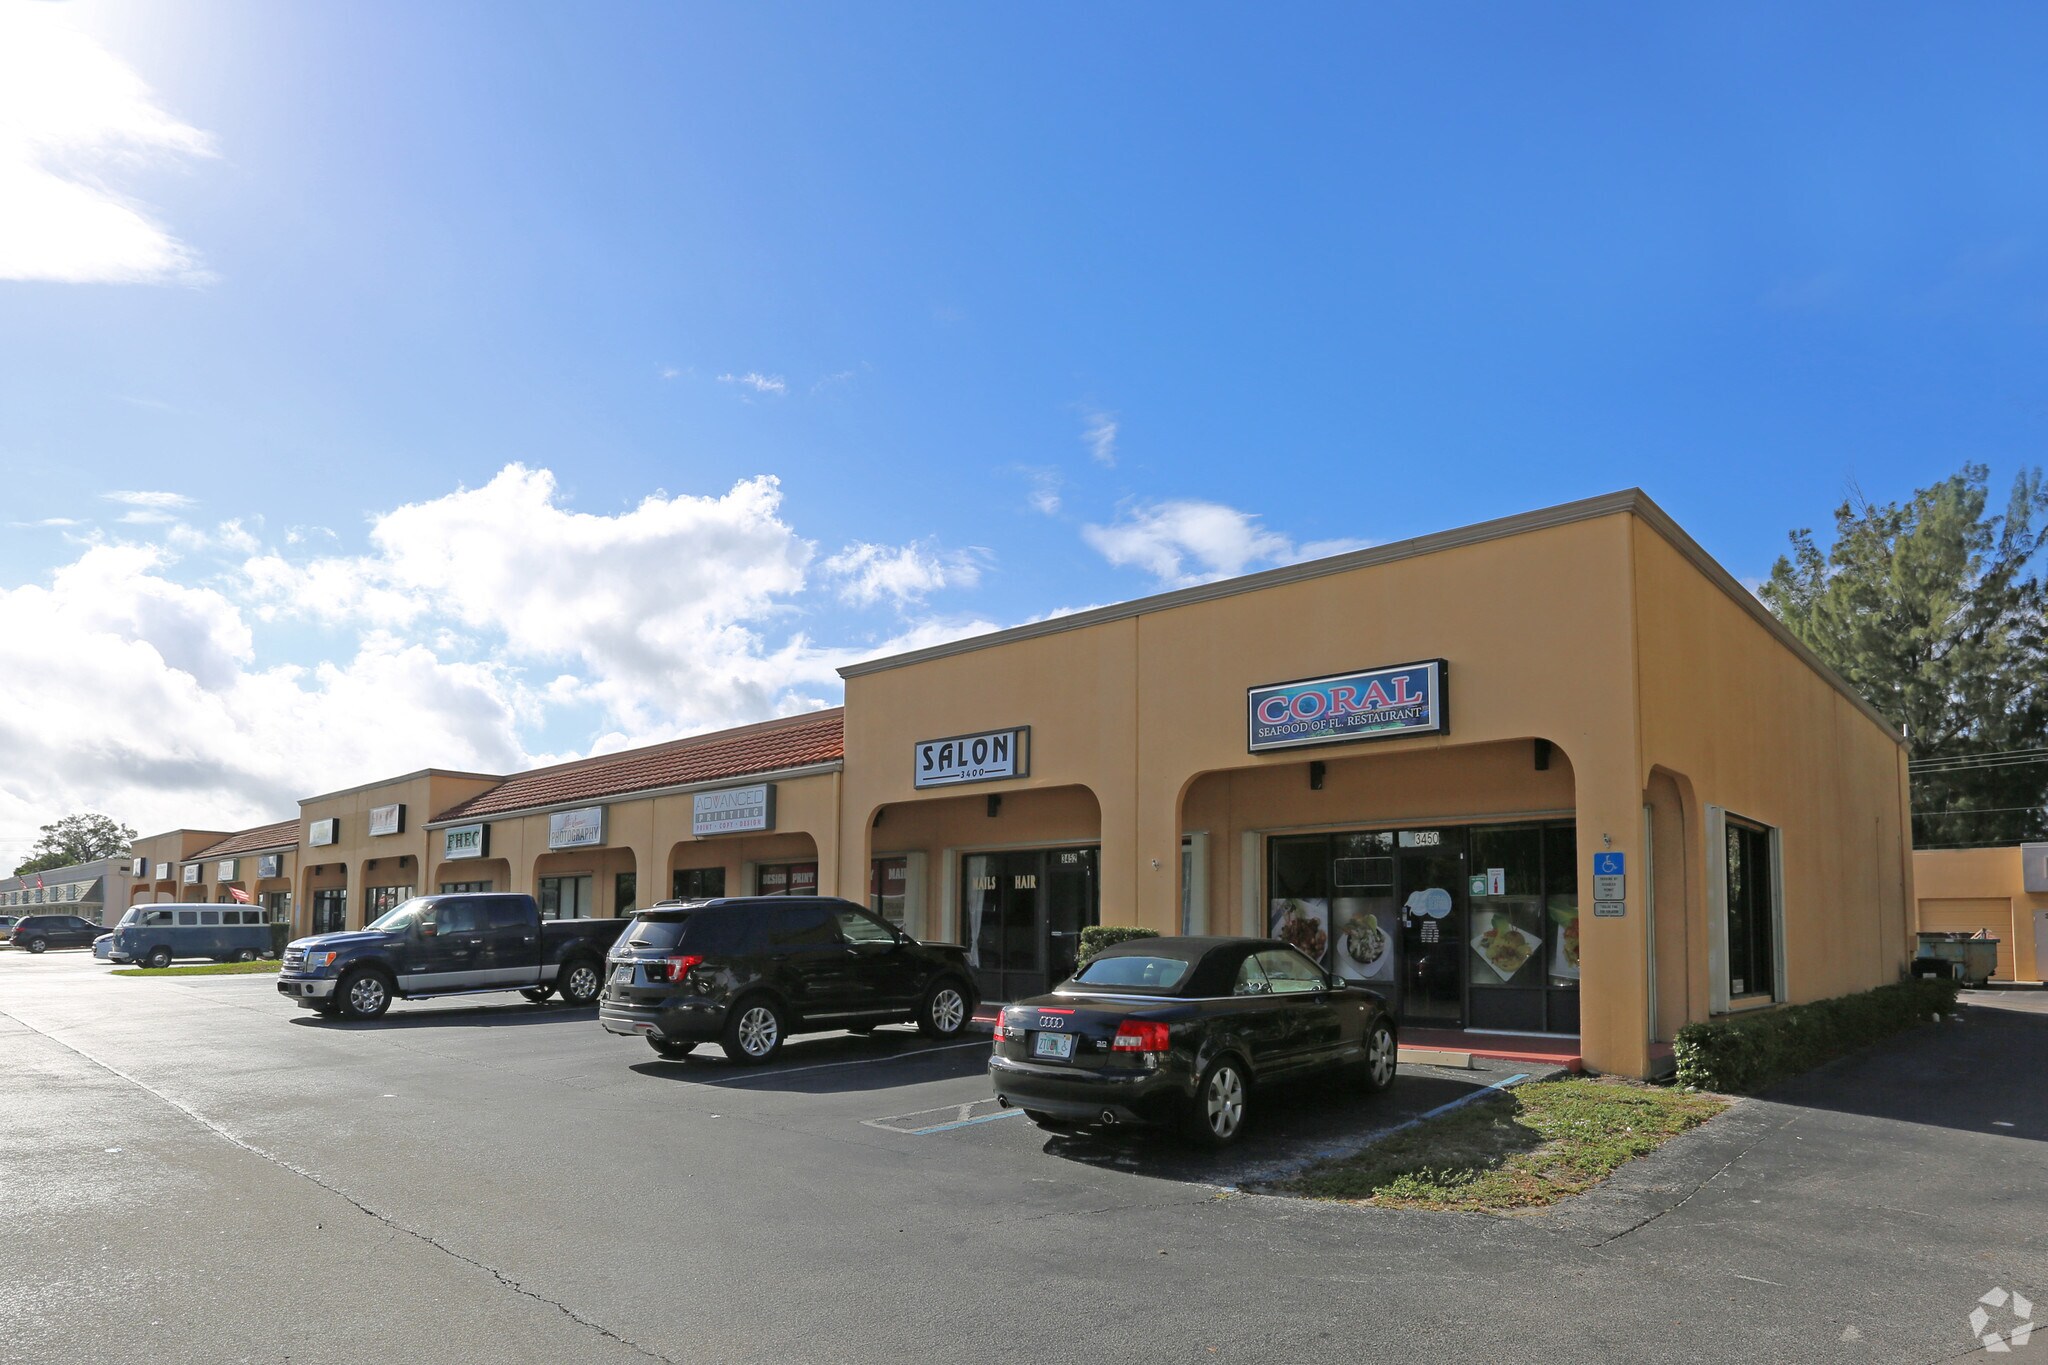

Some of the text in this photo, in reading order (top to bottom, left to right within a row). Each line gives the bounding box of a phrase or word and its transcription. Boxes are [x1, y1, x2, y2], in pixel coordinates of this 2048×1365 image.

[1257, 675, 1423, 724] CORAL
[1258, 707, 1423, 738] SEAFOOD OF FL. RESTAURANT
[922, 735, 1008, 772] SALON
[960, 768, 985, 779] 3400
[696, 789, 764, 811] ADVANCED
[698, 808, 759, 822] PRINTING
[740, 819, 761, 827] DESIGN
[551, 826, 599, 844] PHOTOGRAPHY
[1415, 832, 1440, 845] 3450
[763, 872, 814, 885] DESIGN PRINT
[973, 875, 1036, 890] NAILS HAIR
